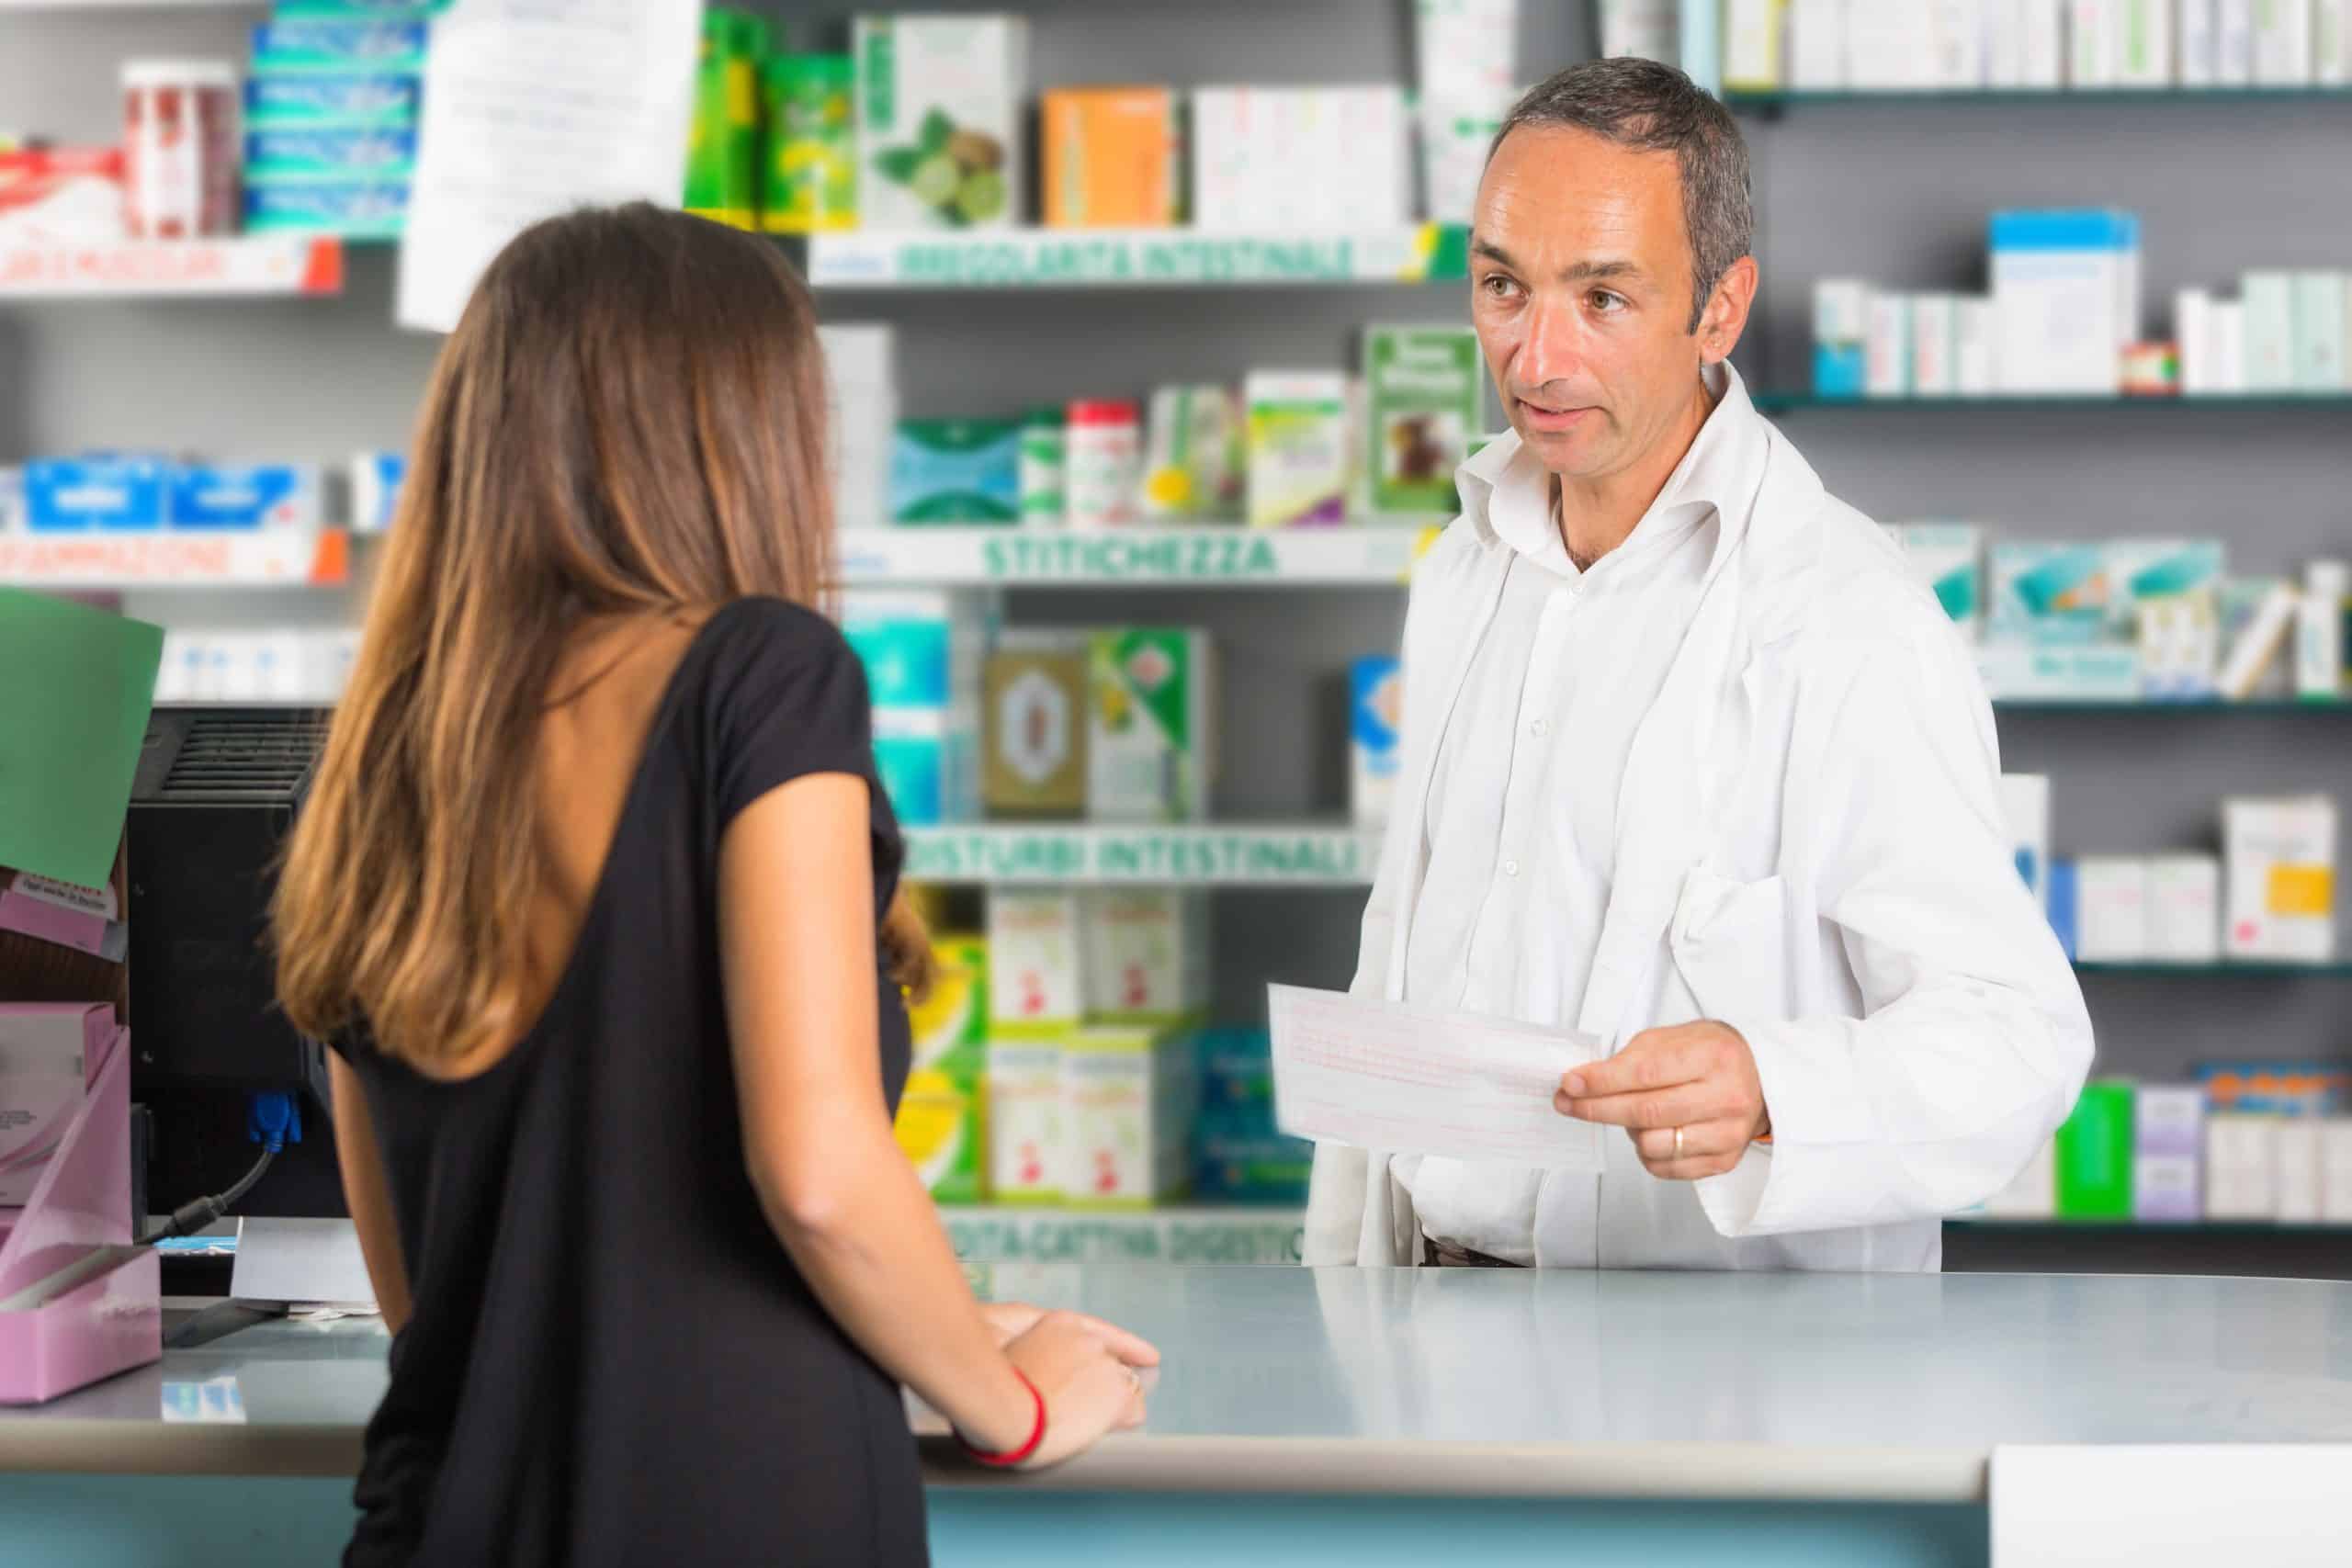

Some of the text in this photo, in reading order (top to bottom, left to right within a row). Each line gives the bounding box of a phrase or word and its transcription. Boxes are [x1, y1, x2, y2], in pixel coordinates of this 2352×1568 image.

[1144, 239, 1354, 280] INTESTINALE
[984, 536, 1276, 577] STITICHEZZA
[1096, 833, 1357, 876] INTESTINALI
